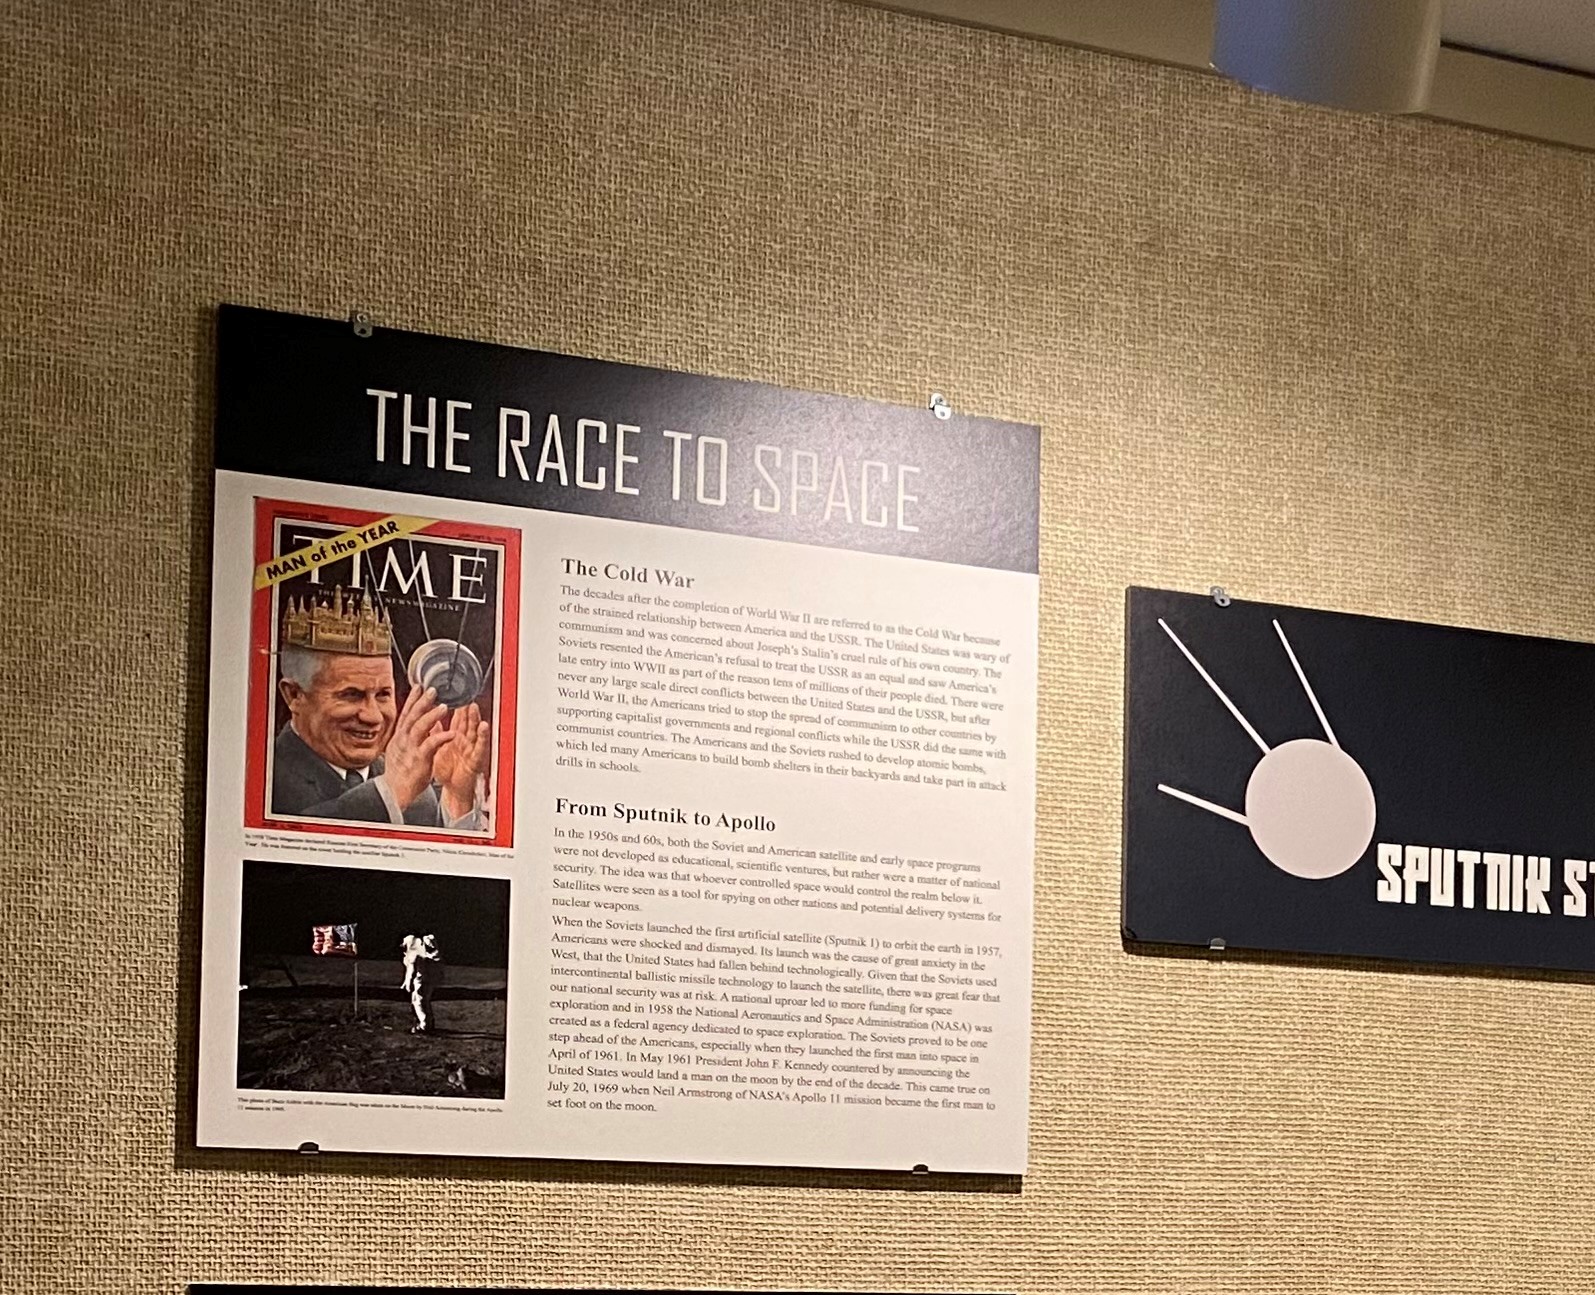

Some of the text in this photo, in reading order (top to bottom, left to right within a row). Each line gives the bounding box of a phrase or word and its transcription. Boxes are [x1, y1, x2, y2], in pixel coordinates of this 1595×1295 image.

[367, 389, 920, 532] THE RACE TO SPACE
[267, 521, 400, 580] MAN of the YEAR
[293, 534, 487, 604] TIME
[560, 558, 694, 588] The Cold War
[555, 755, 640, 772] drills in schools.
[556, 798, 775, 832] From Sputnik to Apollo
[1376, 843, 1551, 915] SPUTNIK
[551, 897, 642, 912] nuclear weapons.
[546, 1097, 656, 1111] set foot on the moon.
